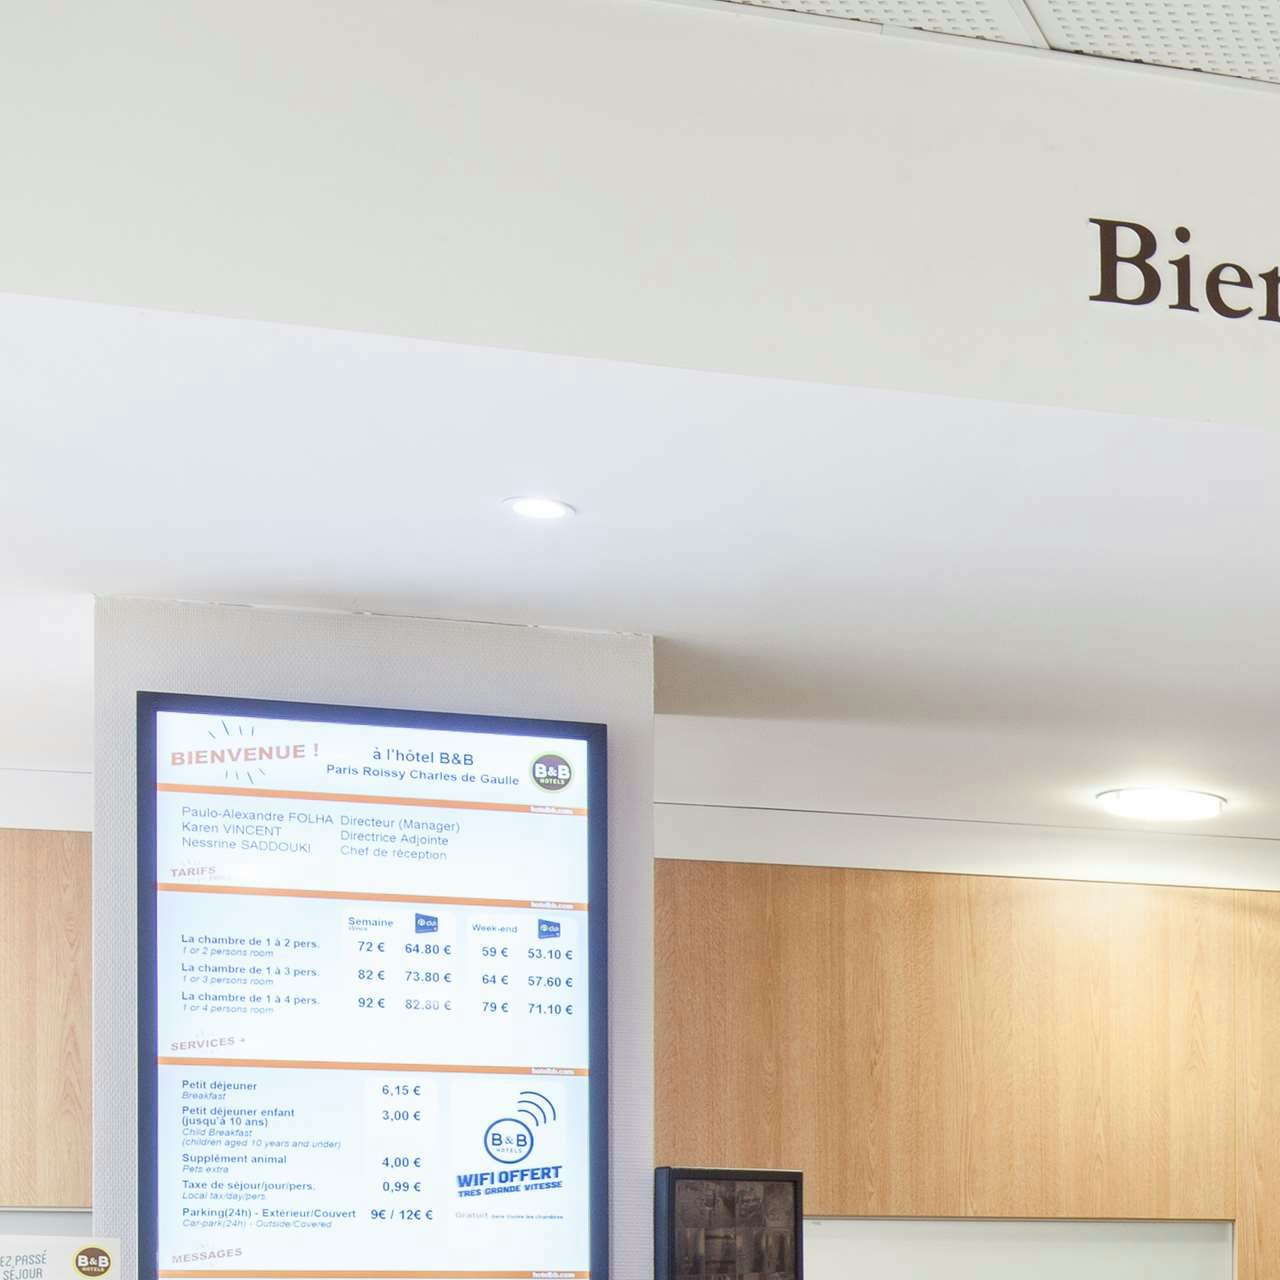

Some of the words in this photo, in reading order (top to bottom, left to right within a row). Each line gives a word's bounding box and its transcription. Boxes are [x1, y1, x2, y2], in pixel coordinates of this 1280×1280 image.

[171, 744, 306, 766] BIENVENUE
[373, 746, 382, 760] à
[386, 748, 435, 763] l'hôtel
[439, 752, 474, 766] B&B
[327, 764, 359, 776] Paris
[363, 766, 406, 781] Roissy
[410, 769, 457, 782] Charles
[461, 772, 476, 783] de
[480, 774, 520, 786] Gaulle
[534, 762, 570, 779] B&B
[539, 777, 565, 785] HOTELS
[182, 806, 284, 822] Paulo-Alexandre
[288, 812, 334, 825] FOLHA
[182, 822, 219, 834] Karen
[223, 824, 282, 837] VINCENT
[340, 814, 396, 828] Directeur
[398, 818, 461, 834] (Manager)
[182, 836, 237, 849] Nessrine
[241, 840, 311, 853] SADDOUKI
[340, 830, 397, 843] Directrice
[400, 834, 449, 847] Adjointe
[340, 845, 368, 856] Chef
[373, 846, 388, 857] de
[392, 848, 448, 862] réception
[170, 866, 217, 878] TARIFS
[348, 916, 395, 928] Semaine
[472, 923, 518, 934] Week-end
[181, 934, 194, 944] La
[198, 935, 246, 946] chambre
[249, 937, 262, 946] de
[284, 938, 291, 948] 2
[293, 940, 320, 950] pers.
[357, 941, 373, 953] 72
[405, 943, 440, 955] 64.80
[481, 946, 497, 957] 59
[527, 948, 561, 960] 53.10
[181, 963, 194, 972] La
[198, 963, 246, 974] chambre
[249, 966, 262, 974] de
[284, 967, 291, 976] 3
[293, 968, 320, 978] pers.
[357, 969, 373, 980] 82
[405, 971, 440, 983] 73.80
[481, 974, 497, 985] 64
[527, 975, 561, 987] 57.60
[181, 992, 194, 1001] La
[198, 992, 246, 1002] chambre
[249, 993, 262, 1002] de
[284, 995, 291, 1003] 4
[293, 996, 320, 1006] pers.
[357, 997, 373, 1009] 92
[481, 1002, 497, 1012] 79
[527, 1003, 562, 1015] 71.10
[170, 1036, 236, 1051] SERVICES
[182, 1080, 207, 1090] Petit
[210, 1080, 257, 1092] déjeuner
[381, 1085, 410, 1097] 6,15
[182, 1091, 226, 1100] Breakfast
[182, 1106, 207, 1116] Petit
[210, 1106, 257, 1118] déjeuner
[260, 1108, 295, 1118] enfant
[382, 1110, 410, 1122] 3,00
[230, 1117, 242, 1126] 10
[245, 1118, 269, 1128] ans)
[182, 1128, 205, 1137] Child
[208, 1128, 253, 1137] Breakfast
[224, 1139, 247, 1149] aged
[252, 1139, 262, 1147] 10
[264, 1141, 289, 1150] years
[292, 1140, 309, 1149] and
[491, 1133, 527, 1147] B&B
[182, 1153, 247, 1165] Supplément
[251, 1154, 287, 1164] animal
[382, 1157, 410, 1169] 4,00
[206, 1165, 229, 1173] extra
[456, 1171, 495, 1188] WIFI
[498, 1165, 563, 1183] OFFERT
[182, 1180, 208, 1190] Taxe
[211, 1181, 224, 1190] de
[382, 1182, 410, 1193] 0,99
[458, 1188, 481, 1198] TRES
[485, 1185, 521, 1196] GRANDE
[524, 1181, 563, 1191] VITESSE
[182, 1192, 208, 1200] Local
[182, 1208, 252, 1219] Parking(24h)
[370, 1209, 386, 1220] 9€
[399, 1209, 421, 1220] 12€
[15, 1249, 47, 1268] PASSÉ
[77, 1255, 109, 1268] B&B
[172, 1247, 243, 1264] MESSAGES
[3, 1266, 42, 1280] SÉJOUR
